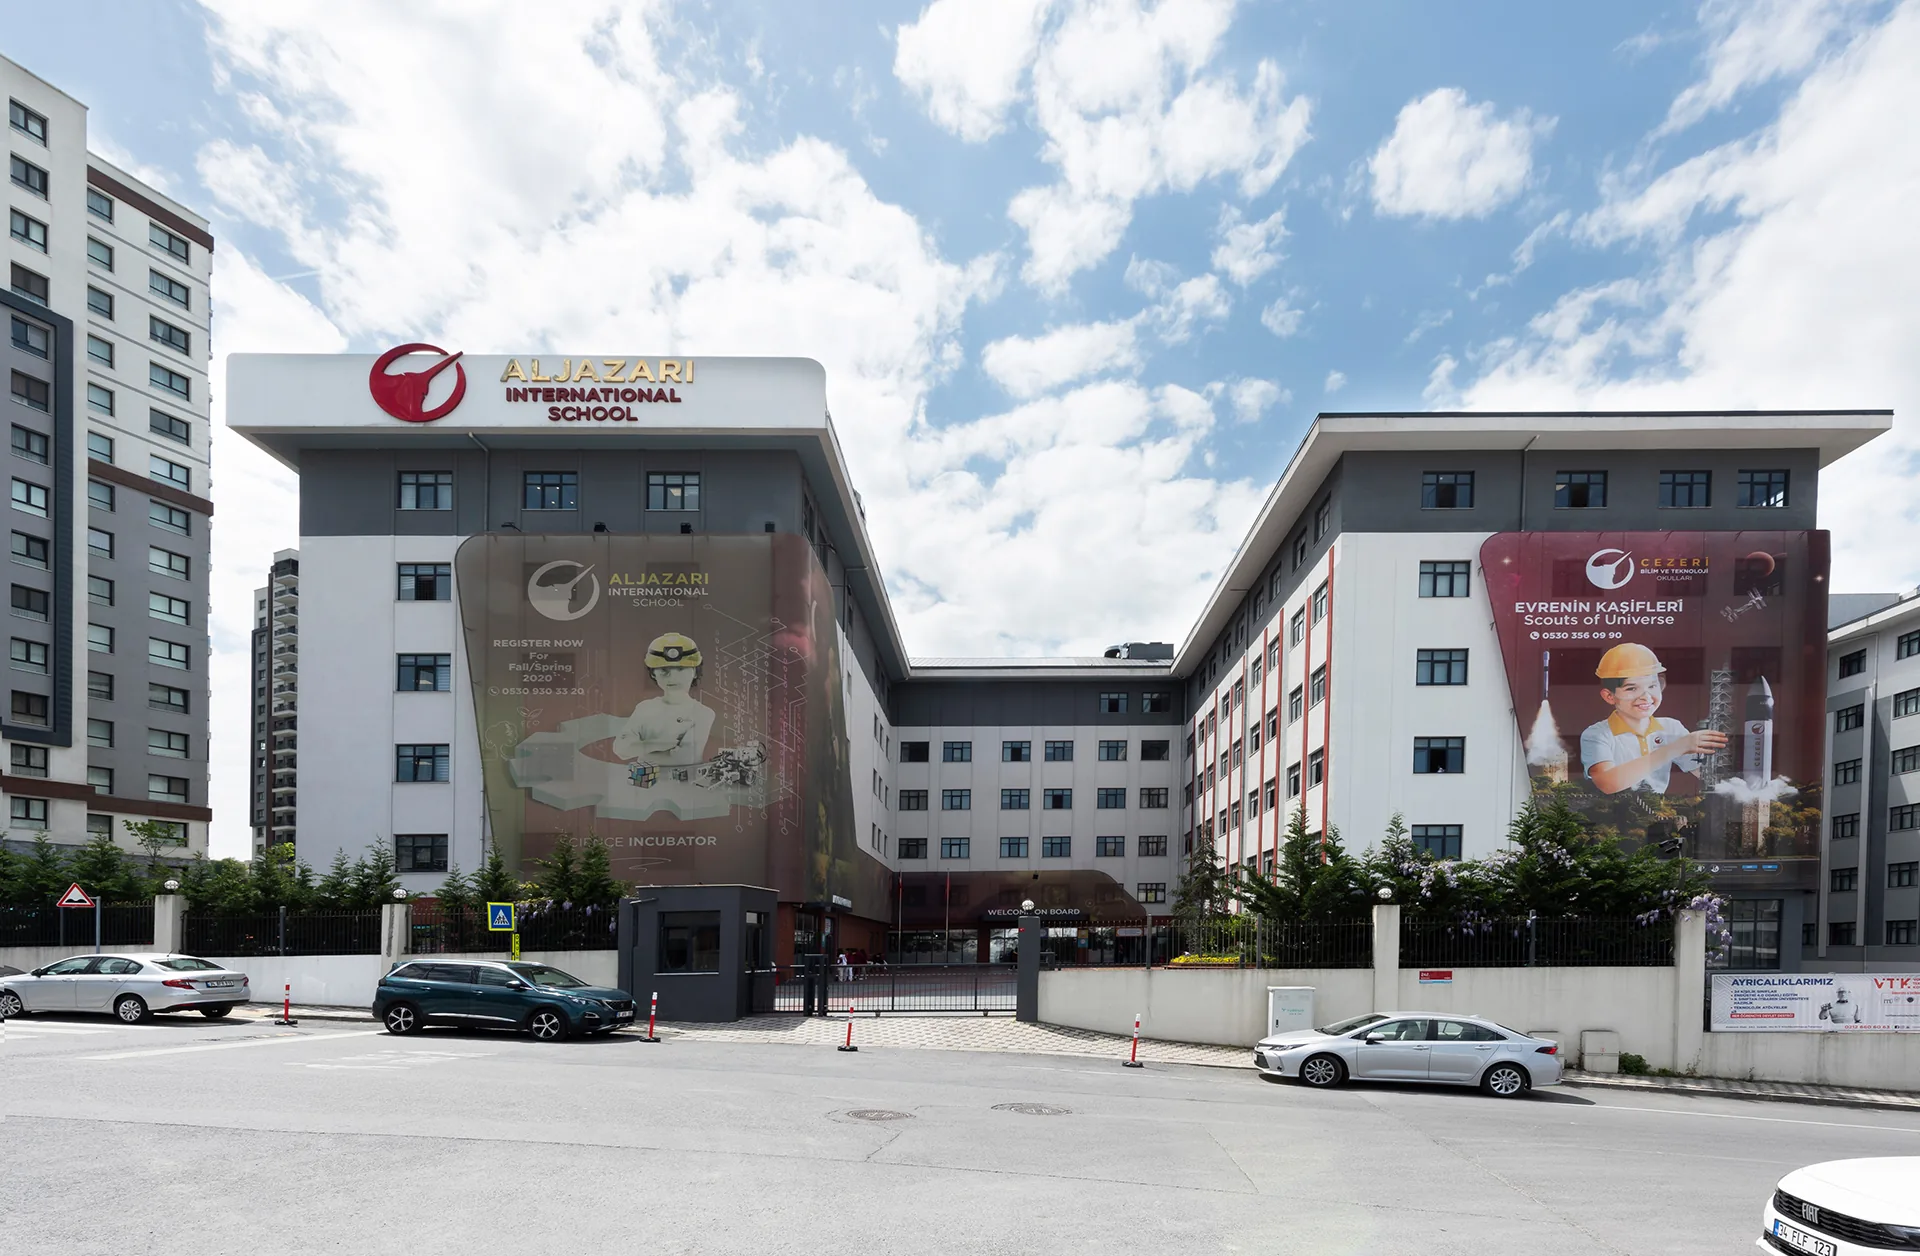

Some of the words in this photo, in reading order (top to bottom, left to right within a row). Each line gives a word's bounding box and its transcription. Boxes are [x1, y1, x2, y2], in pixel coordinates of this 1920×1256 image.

[500, 358, 695, 384] ALJAZARI
[506, 388, 682, 403] INTERNATIONAL
[548, 406, 638, 422] SCHOOL
[1641, 557, 1709, 567] CEZERİ
[609, 572, 709, 585] ALJAZARI
[608, 587, 709, 596] INTERNATIONAL
[632, 598, 684, 607] SCHOOL
[1515, 600, 1590, 613] EVRENİN
[1596, 599, 1683, 614] KAŞİFLERİ
[1524, 614, 1578, 625] Scouts
[1583, 614, 1600, 625] of
[1605, 614, 1675, 625] Universe
[493, 640, 551, 648] REGISTER
[554, 640, 584, 648] NOW
[529, 652, 549, 660] For
[508, 663, 572, 672] Fall/Spring
[522, 674, 553, 682] 2020
[502, 687, 529, 695] 0530
[532, 687, 552, 695] 930
[555, 687, 568, 695] 33
[571, 687, 585, 695] 20
[629, 836, 717, 847] INCUBATOR
[1731, 978, 1833, 986] AYRICALIKLARIMIZ
[1802, 1202, 1820, 1224] FIAT
[1779, 1224, 1788, 1239] 34
[1792, 1230, 1808, 1247] FLF
[1814, 1240, 1831, 1256] 123
